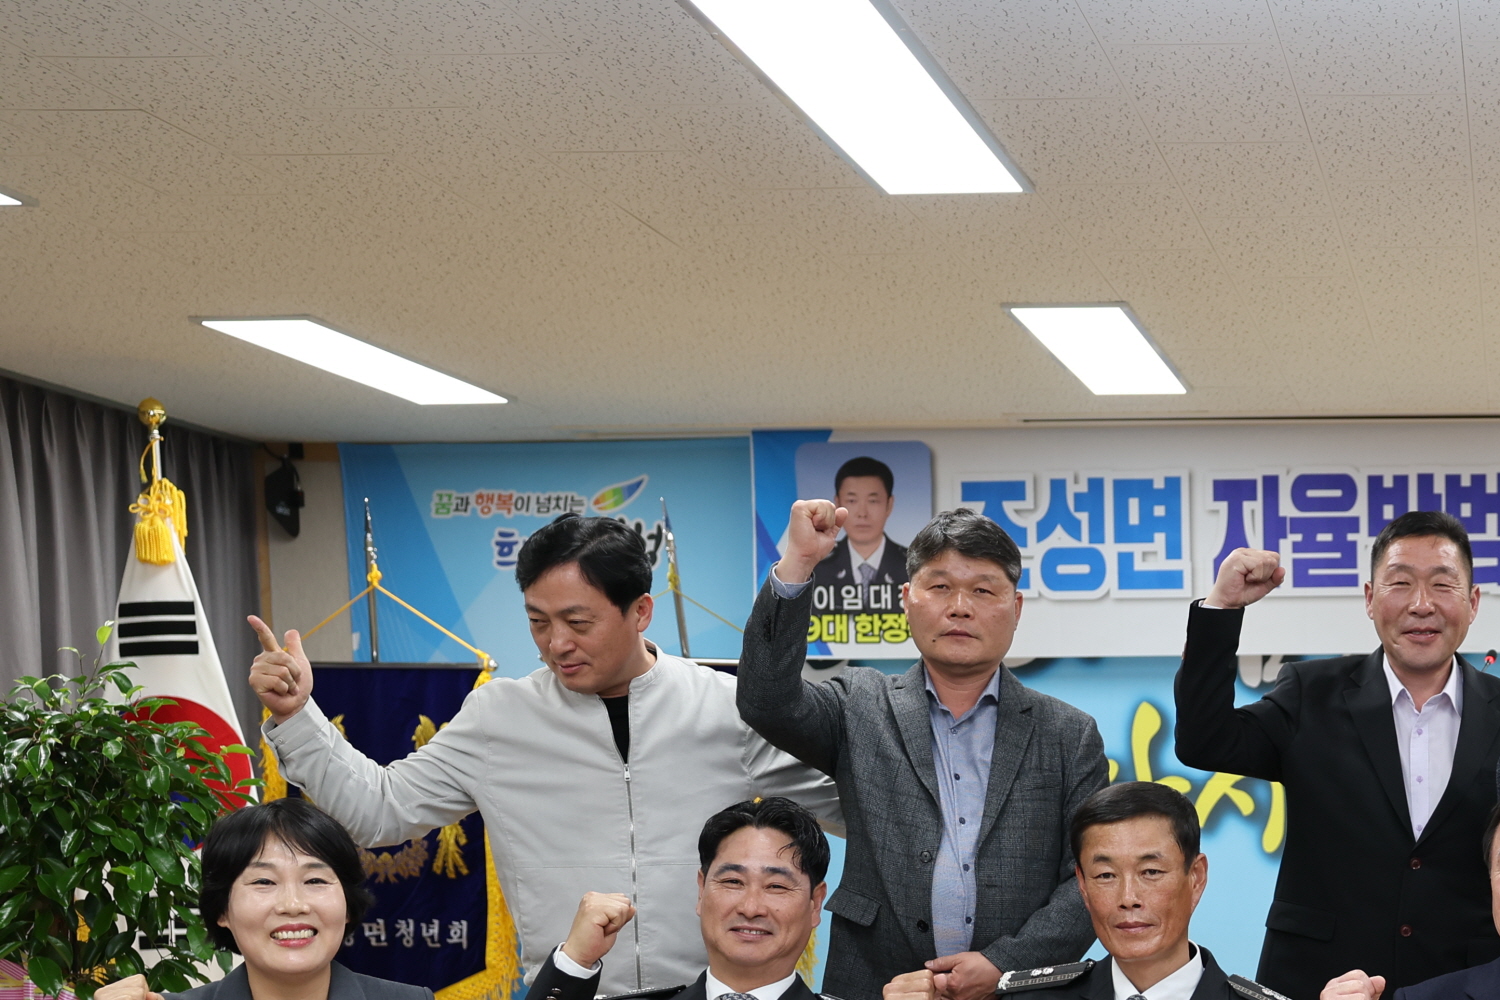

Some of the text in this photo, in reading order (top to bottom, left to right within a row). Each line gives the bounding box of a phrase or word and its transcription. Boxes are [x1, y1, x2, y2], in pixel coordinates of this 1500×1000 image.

[434, 491, 585, 515] 꿈과 행복이 넘치는
[960, 475, 1184, 592] 조성면
[813, 584, 906, 611] 이임대
[854, 613, 912, 644] 한정
